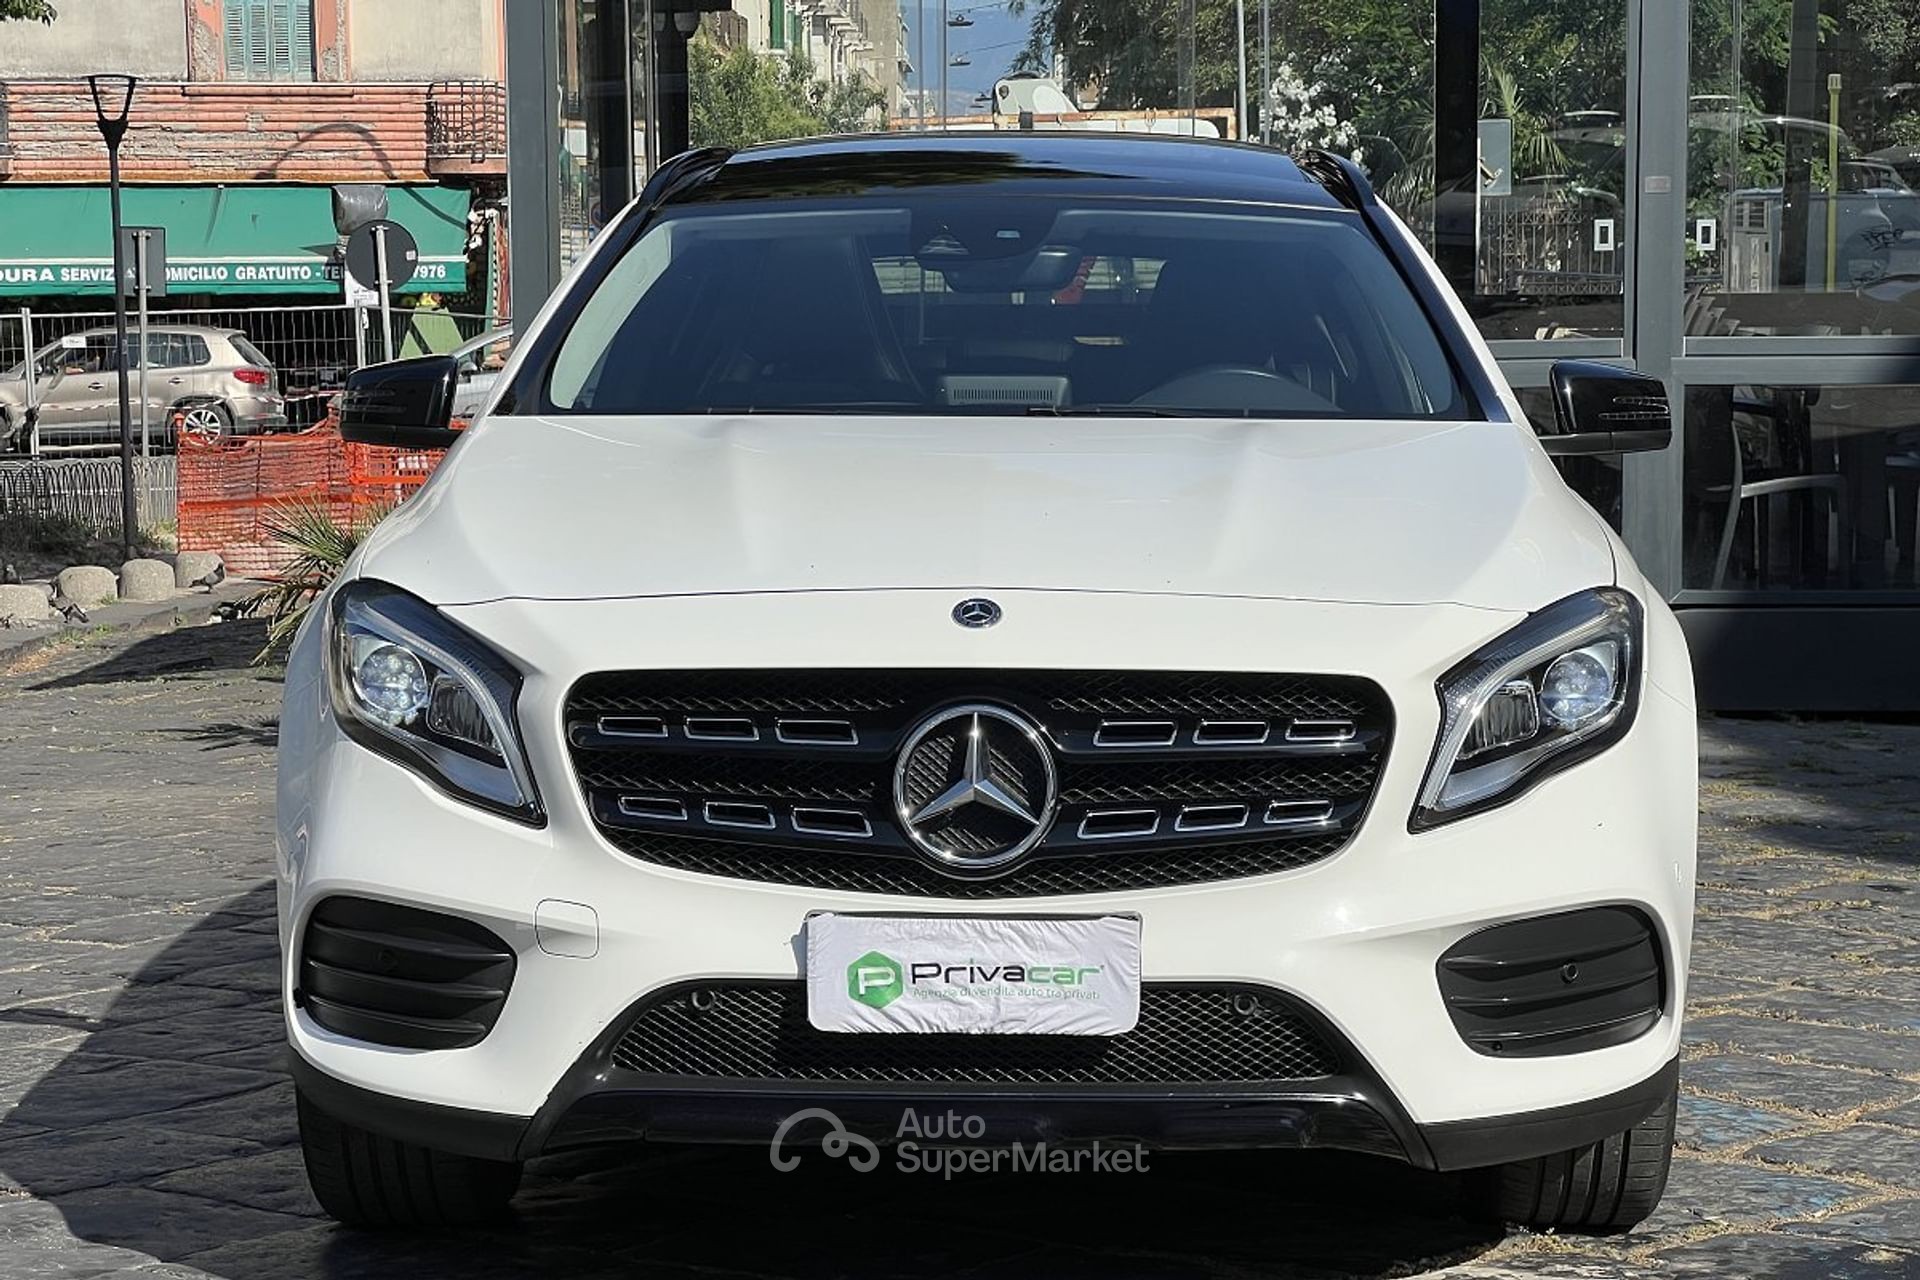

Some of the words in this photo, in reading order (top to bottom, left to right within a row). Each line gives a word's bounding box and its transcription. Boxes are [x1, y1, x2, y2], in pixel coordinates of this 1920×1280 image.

[60, 268, 115, 281] SERVIZ
[235, 266, 311, 280] GRATUITO
[911, 958, 1101, 985] Privacar
[1017, 988, 1043, 998] auto
[1045, 988, 1061, 999] tra
